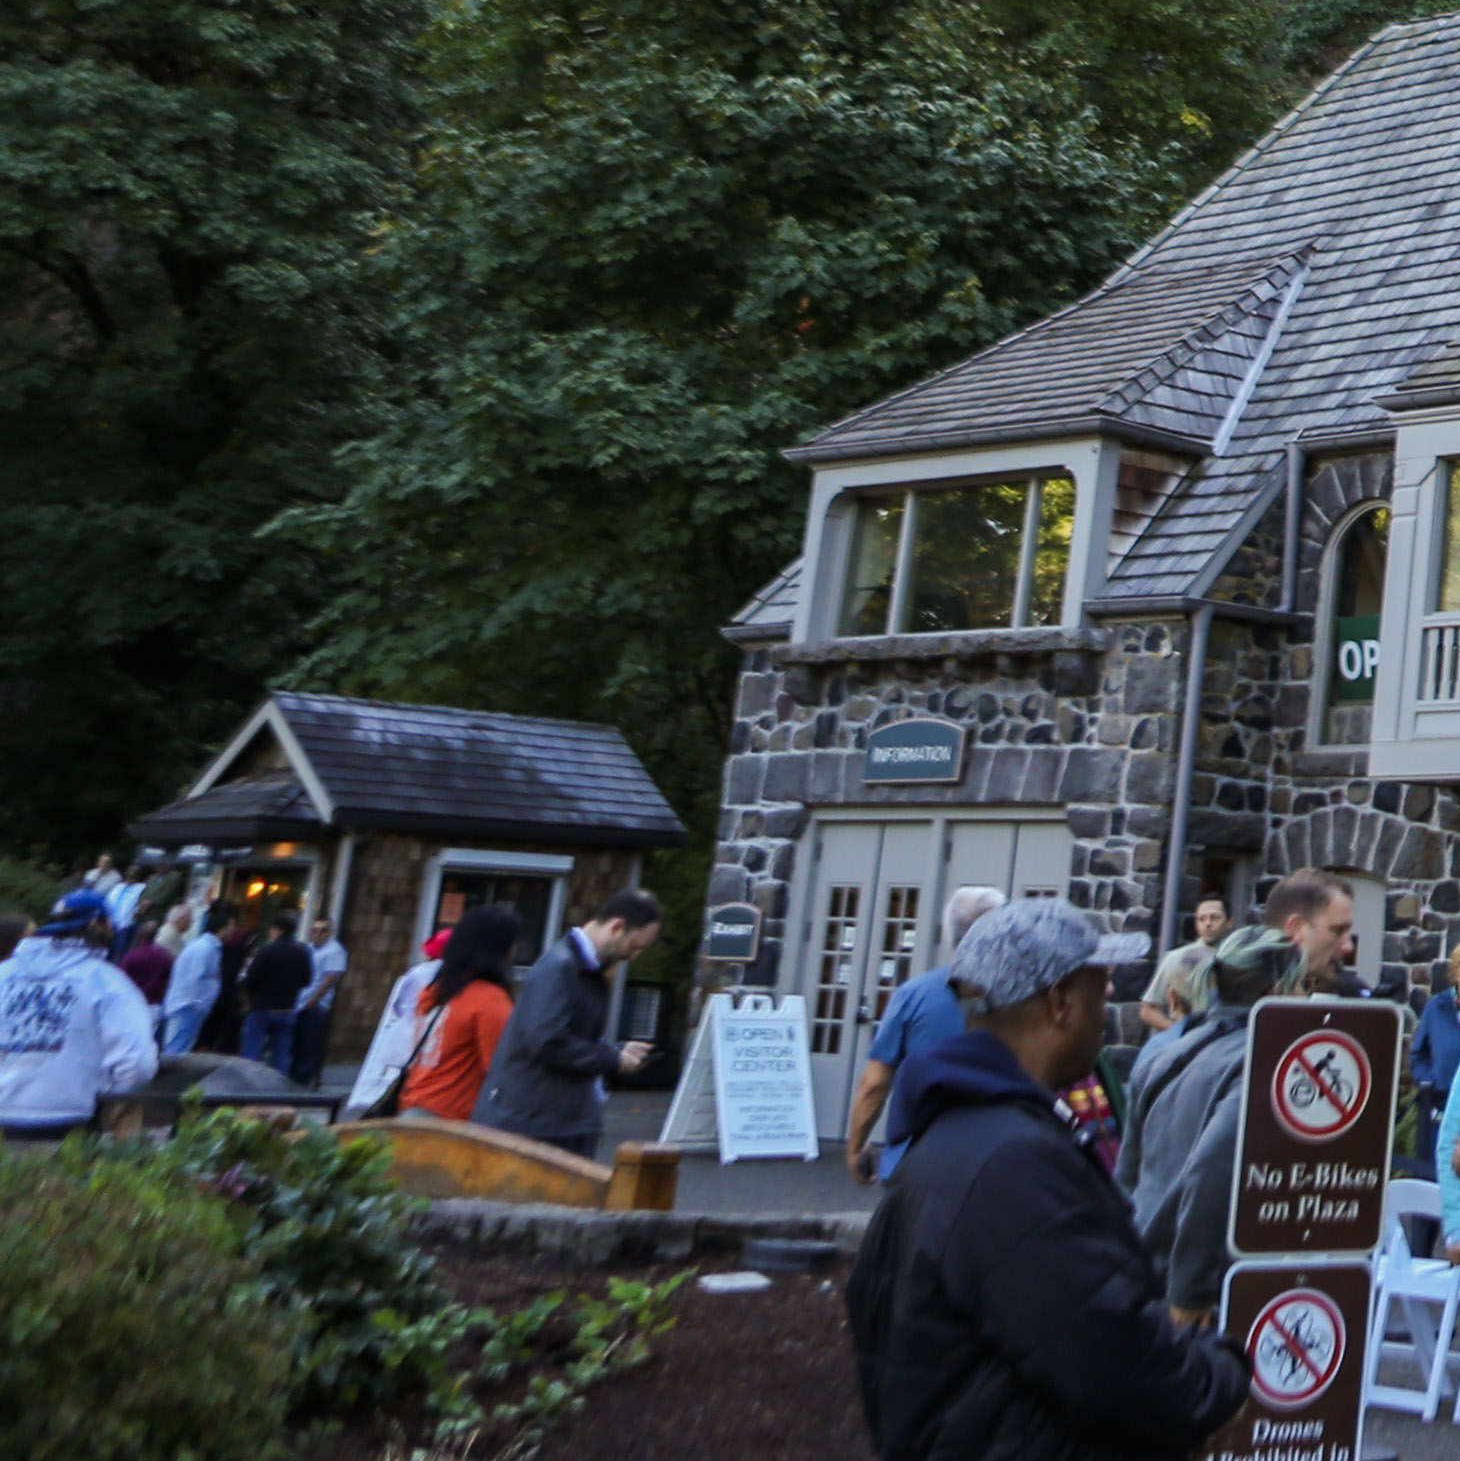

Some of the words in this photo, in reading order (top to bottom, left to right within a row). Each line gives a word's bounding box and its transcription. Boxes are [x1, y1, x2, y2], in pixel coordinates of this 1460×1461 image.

[872, 745, 953, 762] INFORMATION
[742, 1027, 783, 1041] OPEN
[734, 1046, 794, 1058] VISITOR
[732, 1059, 796, 1073] CENTER
[1247, 1162, 1283, 1190] No
[1290, 1161, 1379, 1189] E-Bikes
[1258, 1200, 1290, 1223] on
[1297, 1194, 1360, 1222] Plaza
[1251, 1418, 1324, 1445] Drones
[1220, 1443, 1324, 1461] hibited
